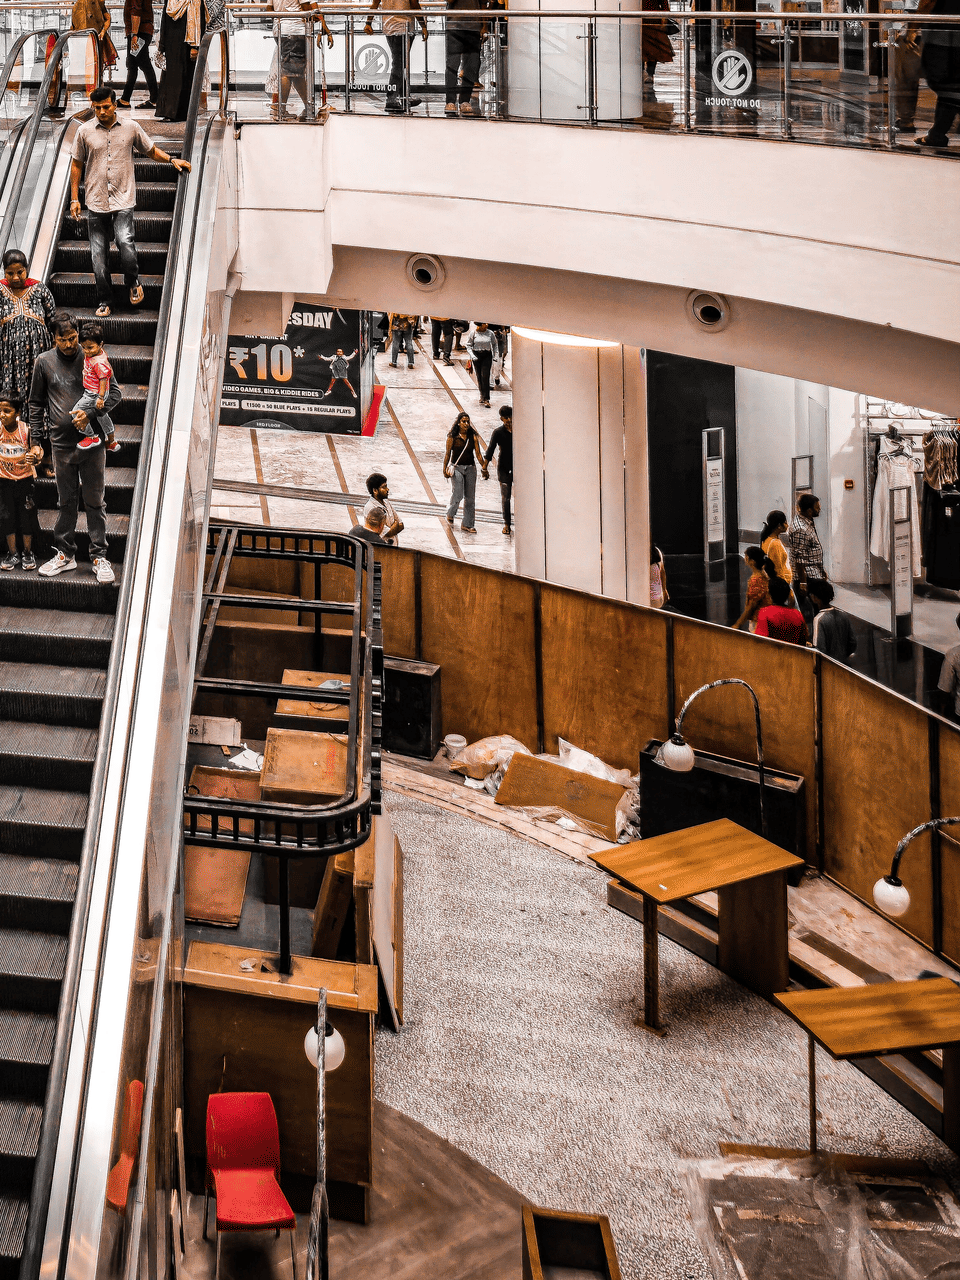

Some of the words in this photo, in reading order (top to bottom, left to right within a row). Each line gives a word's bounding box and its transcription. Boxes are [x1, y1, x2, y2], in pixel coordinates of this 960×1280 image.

[222, 385, 240, 393] VIDEO
[280, 389, 301, 397] KIDDIE
[301, 390, 320, 398] RIDES
[313, 406, 336, 414] REGULAR
